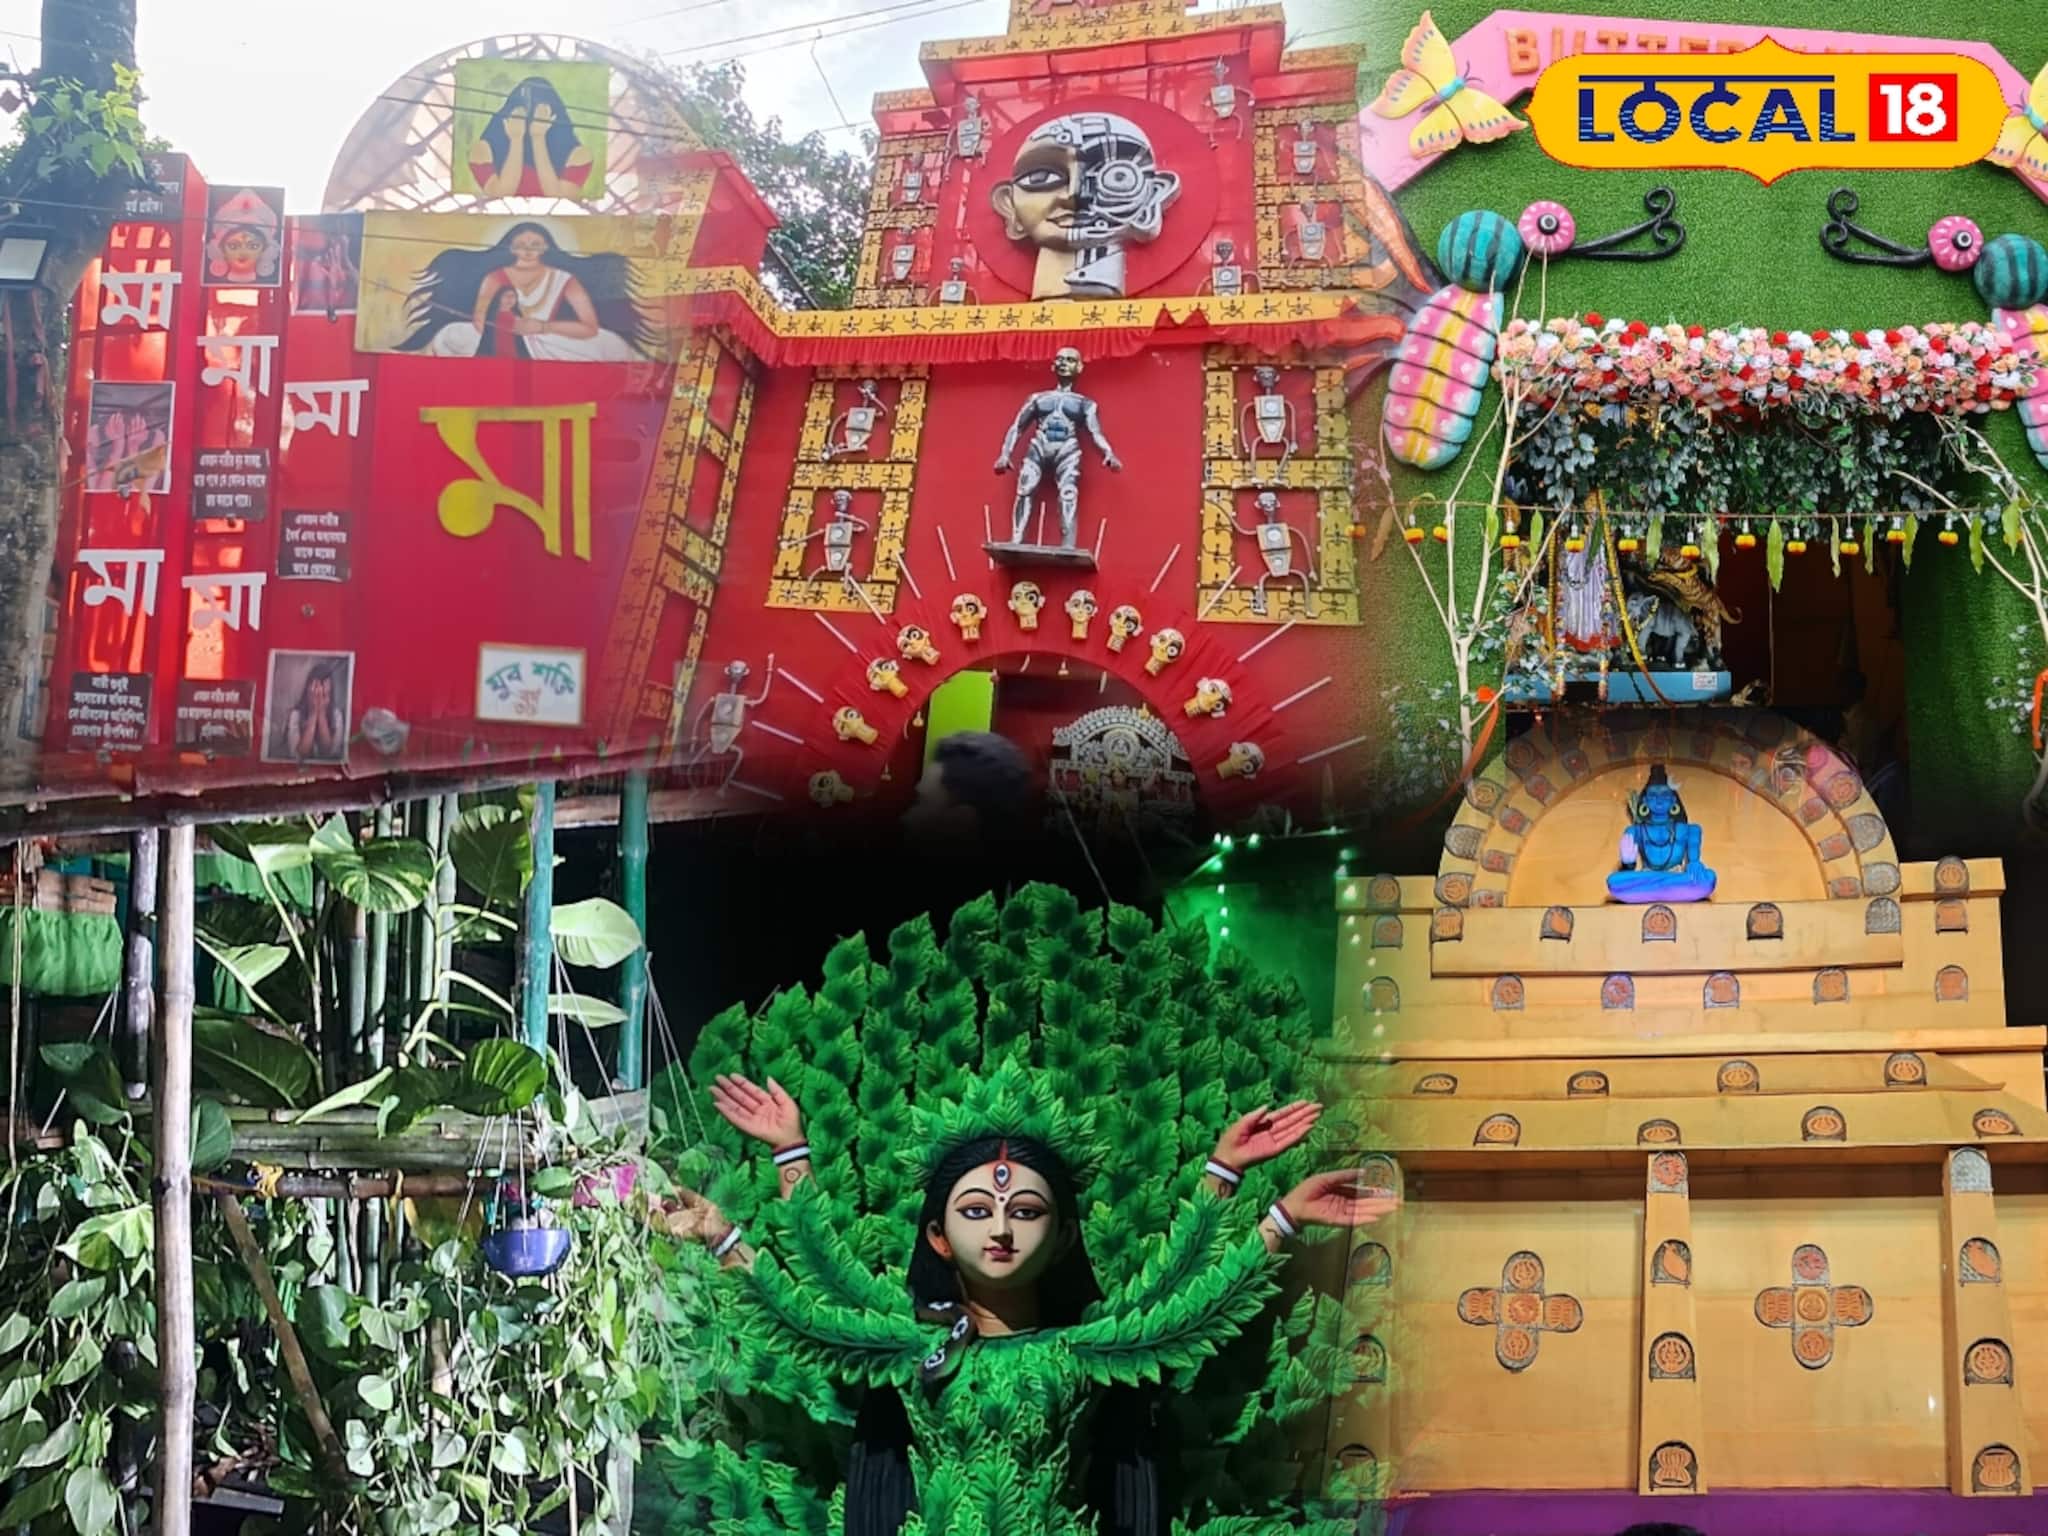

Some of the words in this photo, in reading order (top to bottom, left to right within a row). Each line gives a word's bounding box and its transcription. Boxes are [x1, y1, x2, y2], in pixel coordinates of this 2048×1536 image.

[100, 272, 182, 330] মা
[197, 336, 279, 397] মা
[284, 379, 369, 437] মা
[419, 402, 597, 562] মা
[77, 549, 165, 617] মা
[182, 572, 267, 631] মা
